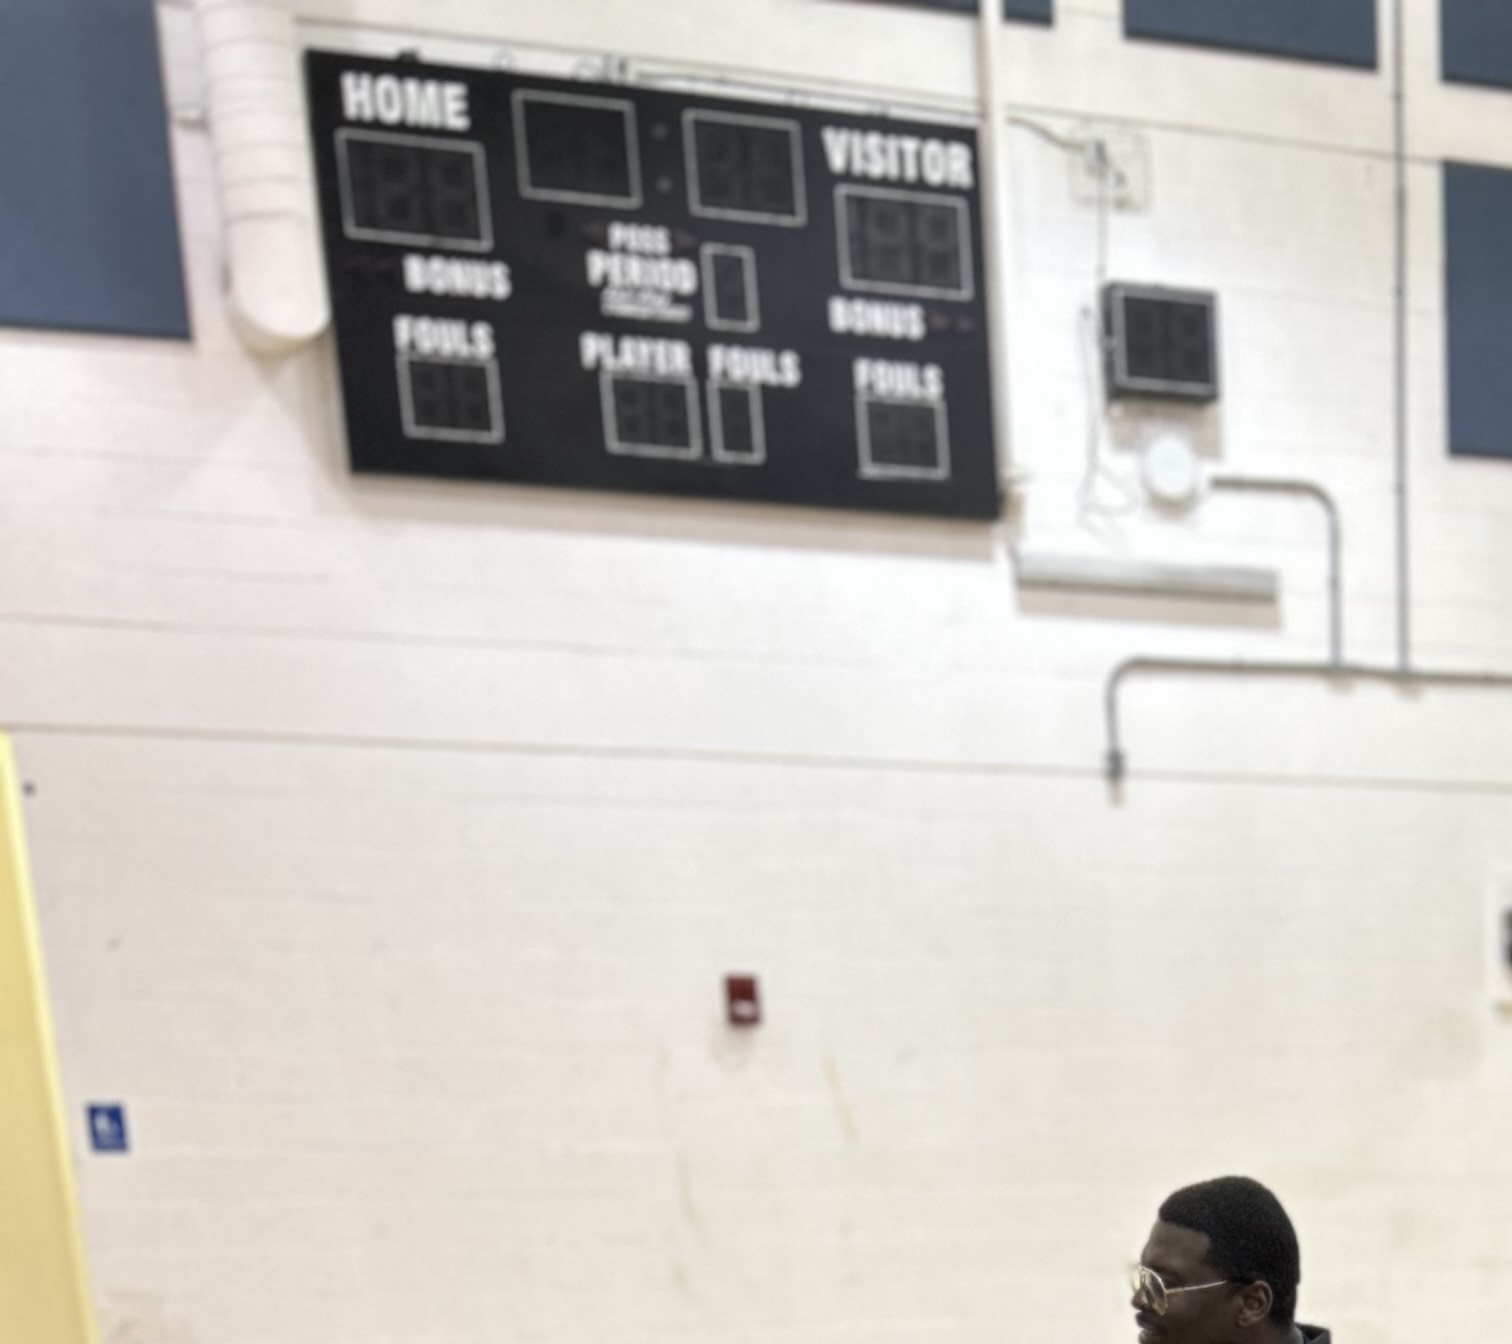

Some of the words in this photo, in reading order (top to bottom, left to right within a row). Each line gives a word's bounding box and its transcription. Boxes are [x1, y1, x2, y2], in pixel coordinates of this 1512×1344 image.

[341, 72, 471, 131] HOME
[822, 127, 974, 189] VISITOR
[403, 255, 511, 300] BONUS
[586, 249, 698, 297] PERIOD
[394, 315, 494, 360] FOULS
[828, 296, 927, 341] BONUS
[580, 332, 692, 374] PLAYER
[707, 344, 802, 388] FOULS
[853, 357, 945, 400] FOULS
